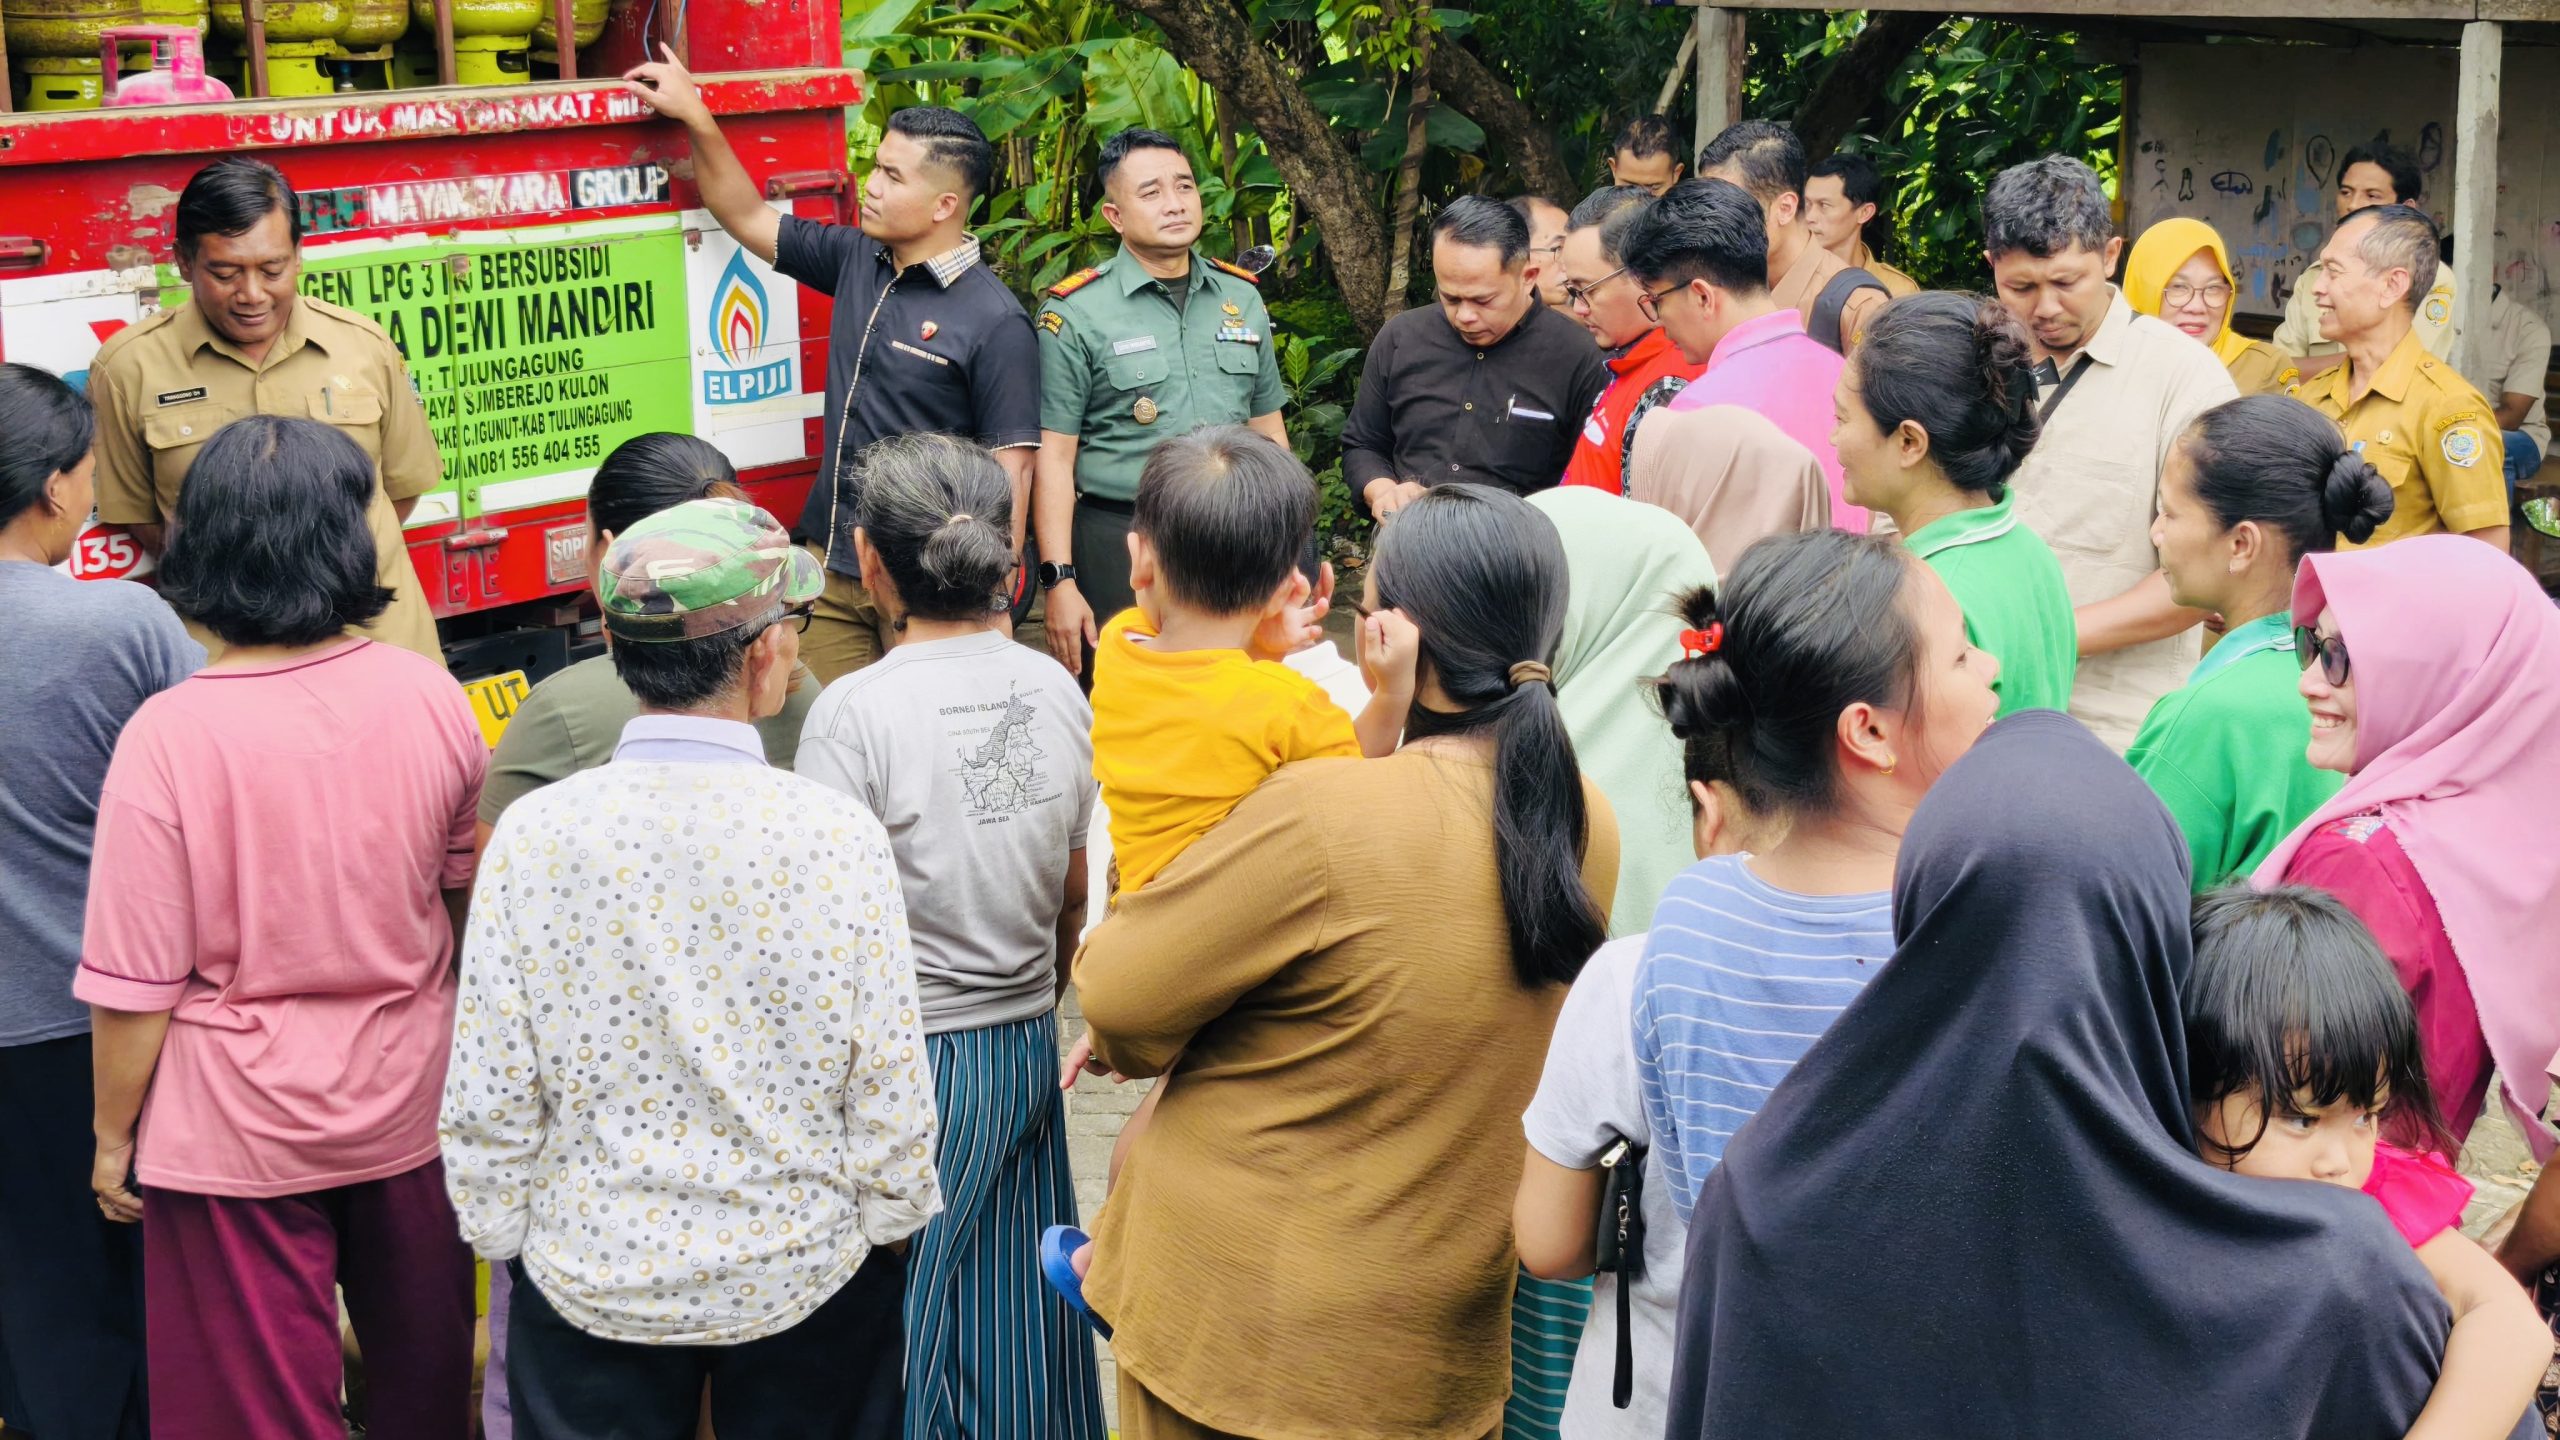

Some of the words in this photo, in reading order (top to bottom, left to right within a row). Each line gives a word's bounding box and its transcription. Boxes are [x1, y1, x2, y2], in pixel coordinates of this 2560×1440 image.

[577, 165, 669, 208] GROUP
[296, 271, 354, 307] GEN
[368, 262, 414, 303] LPG
[480, 245, 611, 291] BERSUBSIDI
[420, 297, 507, 359] DEWI
[518, 280, 655, 346] MANDIRI
[438, 348, 584, 389] TULUNGAGUNG
[709, 364, 787, 400] ELPIJI
[423, 394, 455, 420] AYA
[559, 373, 609, 401] KULON
[549, 399, 633, 433] TULUNGAGUNG
[512, 443, 538, 470] 556
[543, 438, 570, 464] 404
[575, 433, 600, 459] 555
[72, 533, 135, 577] 135
[482, 677, 522, 720] UT
[939, 704, 976, 716] BORNEO
[978, 701, 1009, 712] ISLAND
[977, 817, 997, 826] JAWA
[998, 815, 1010, 823] SEA
